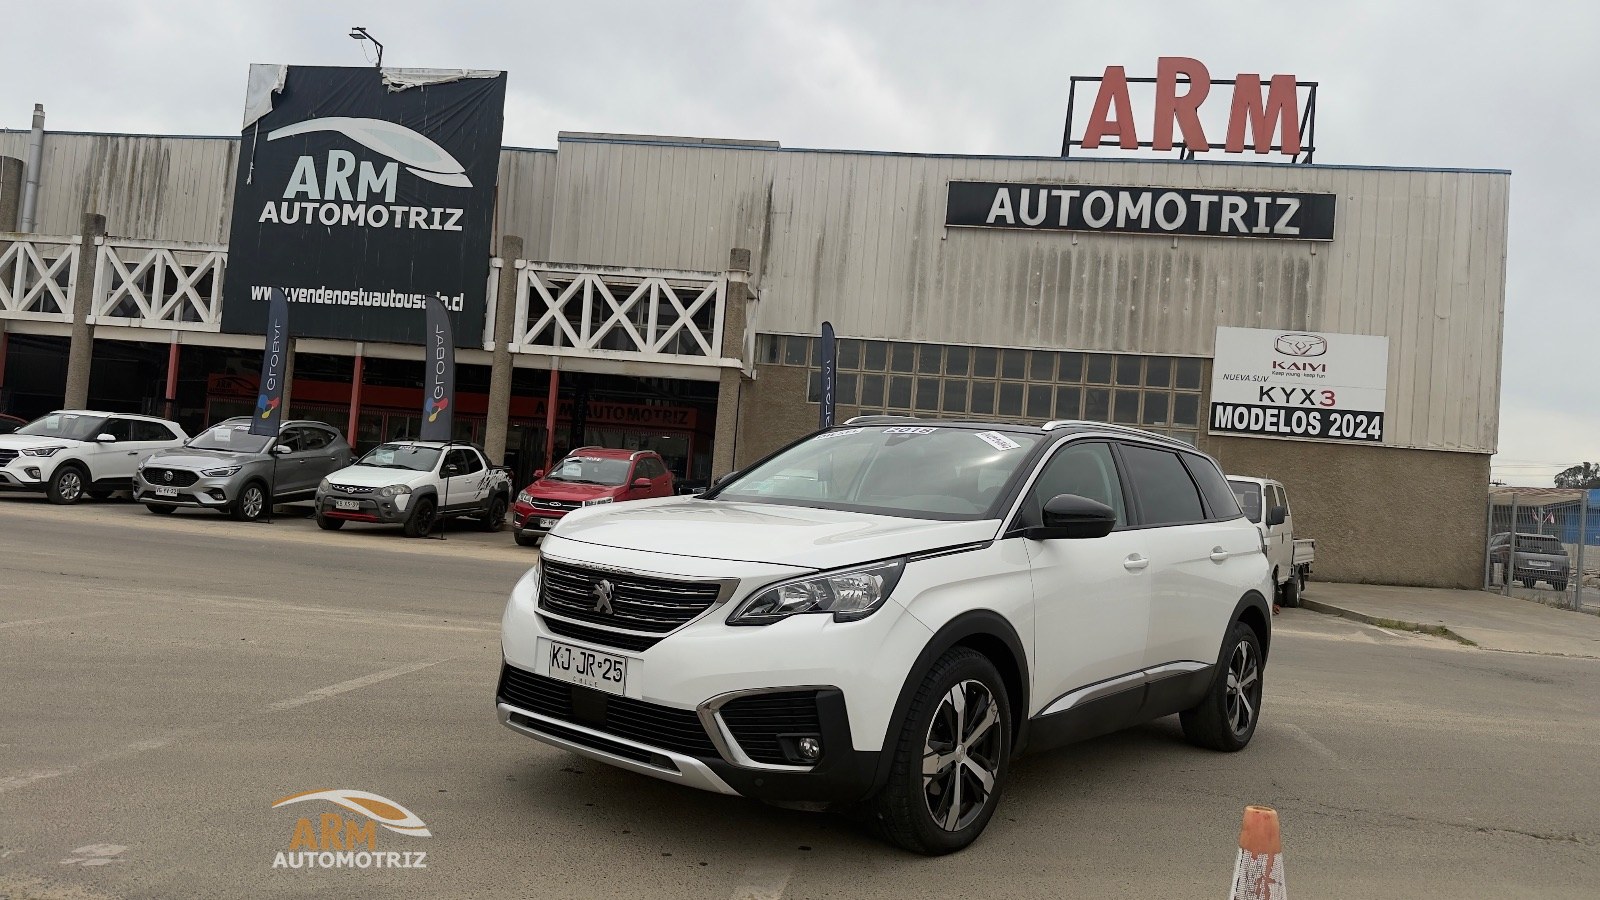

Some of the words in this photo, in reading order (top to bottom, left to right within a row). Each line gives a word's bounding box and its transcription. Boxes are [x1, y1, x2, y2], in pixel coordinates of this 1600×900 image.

[1080, 56, 1301, 155] ARM
[282, 149, 399, 203] ARM
[258, 201, 464, 231] AUTOMOTRIZ
[985, 186, 1302, 236] AUTOMOTRIZ
[266, 318, 281, 391] GLOBAL
[433, 323, 445, 399] GLOBAL
[1222, 373, 1252, 382] NUEVA
[1252, 375, 1269, 383] SUV
[1258, 385, 1336, 407] KYX3
[1214, 405, 1322, 435] MODELOS
[1327, 412, 1381, 440] 2024
